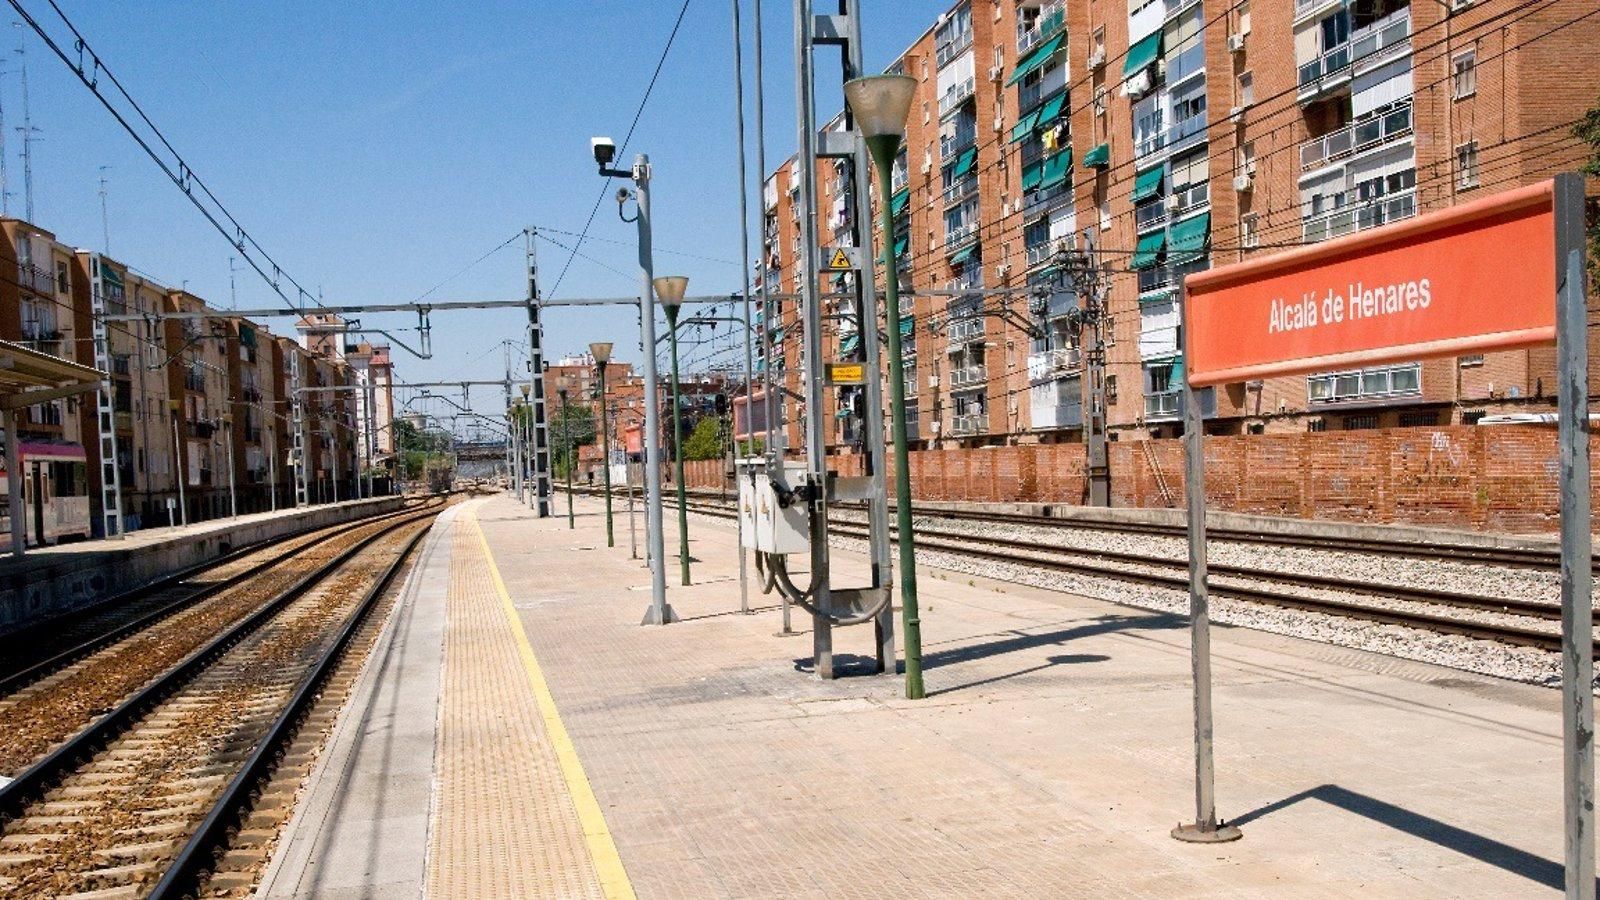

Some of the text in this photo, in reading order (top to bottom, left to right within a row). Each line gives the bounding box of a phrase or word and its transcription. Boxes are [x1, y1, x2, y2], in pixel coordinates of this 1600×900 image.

[1269, 278, 1431, 334] Alcalá de Henares
